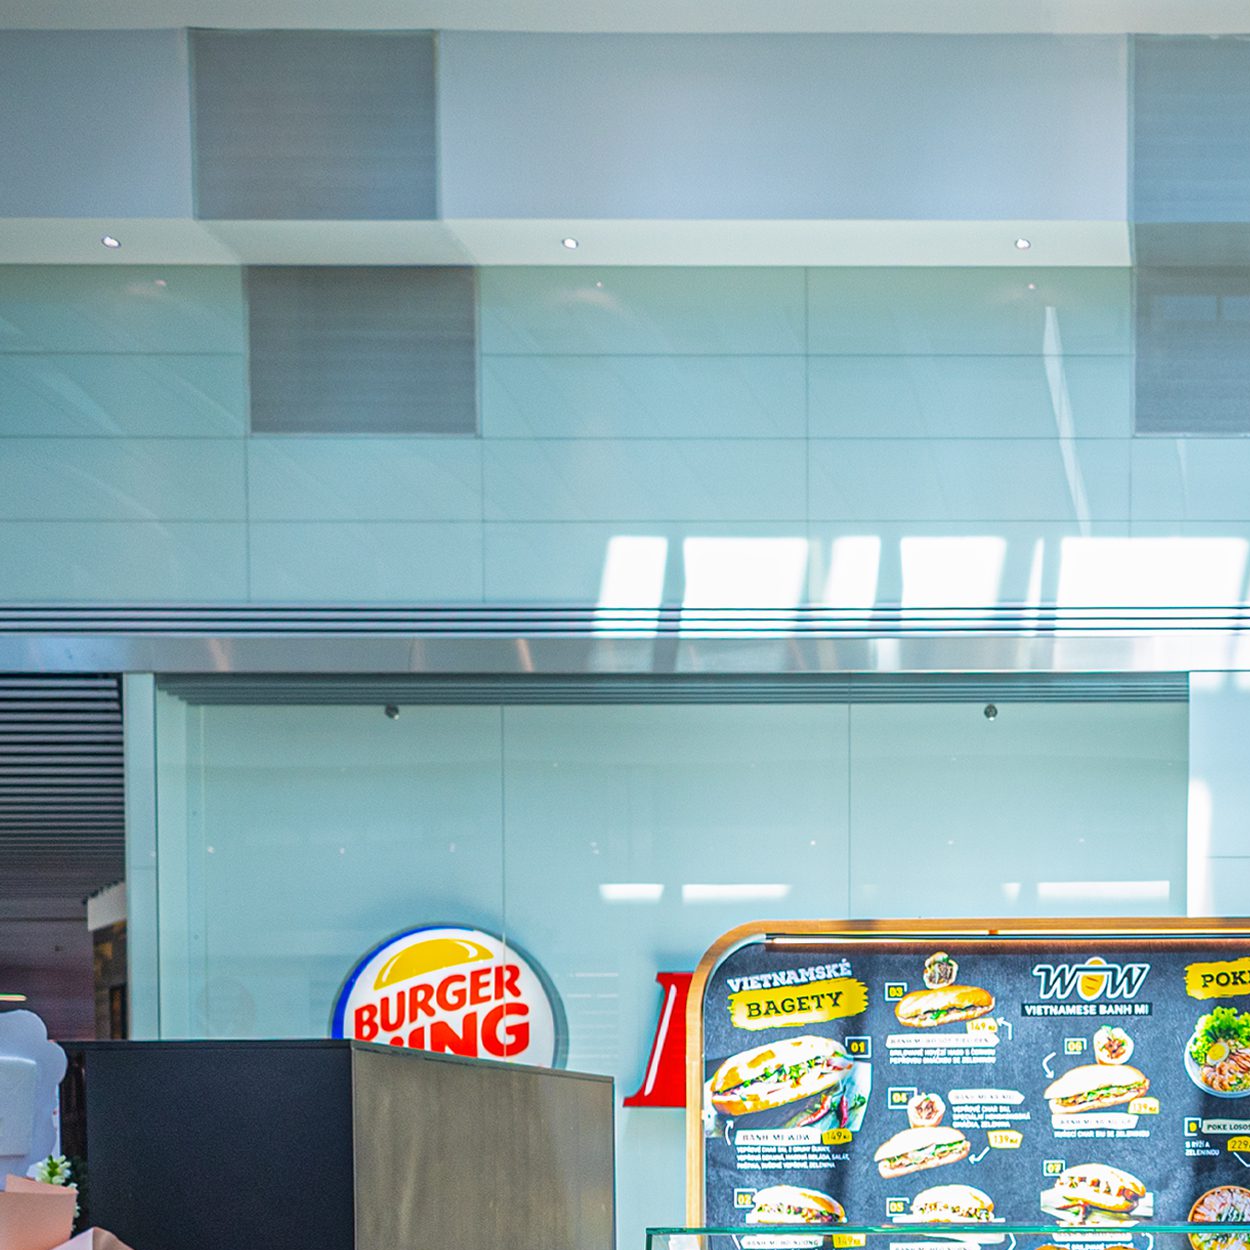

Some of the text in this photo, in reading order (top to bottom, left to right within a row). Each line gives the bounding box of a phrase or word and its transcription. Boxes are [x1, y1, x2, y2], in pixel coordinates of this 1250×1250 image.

[726, 958, 853, 992] VIETNAMSKÉ
[1033, 957, 1151, 1001] WOW
[354, 964, 522, 1041] BURGER
[746, 991, 843, 1018] BAGETY
[1024, 1004, 1149, 1015] VIETNAMESE BANH MI
[851, 1041, 865, 1053] 01
[1207, 1123, 1228, 1131] POKE
[1230, 1140, 1248, 1149] 229
